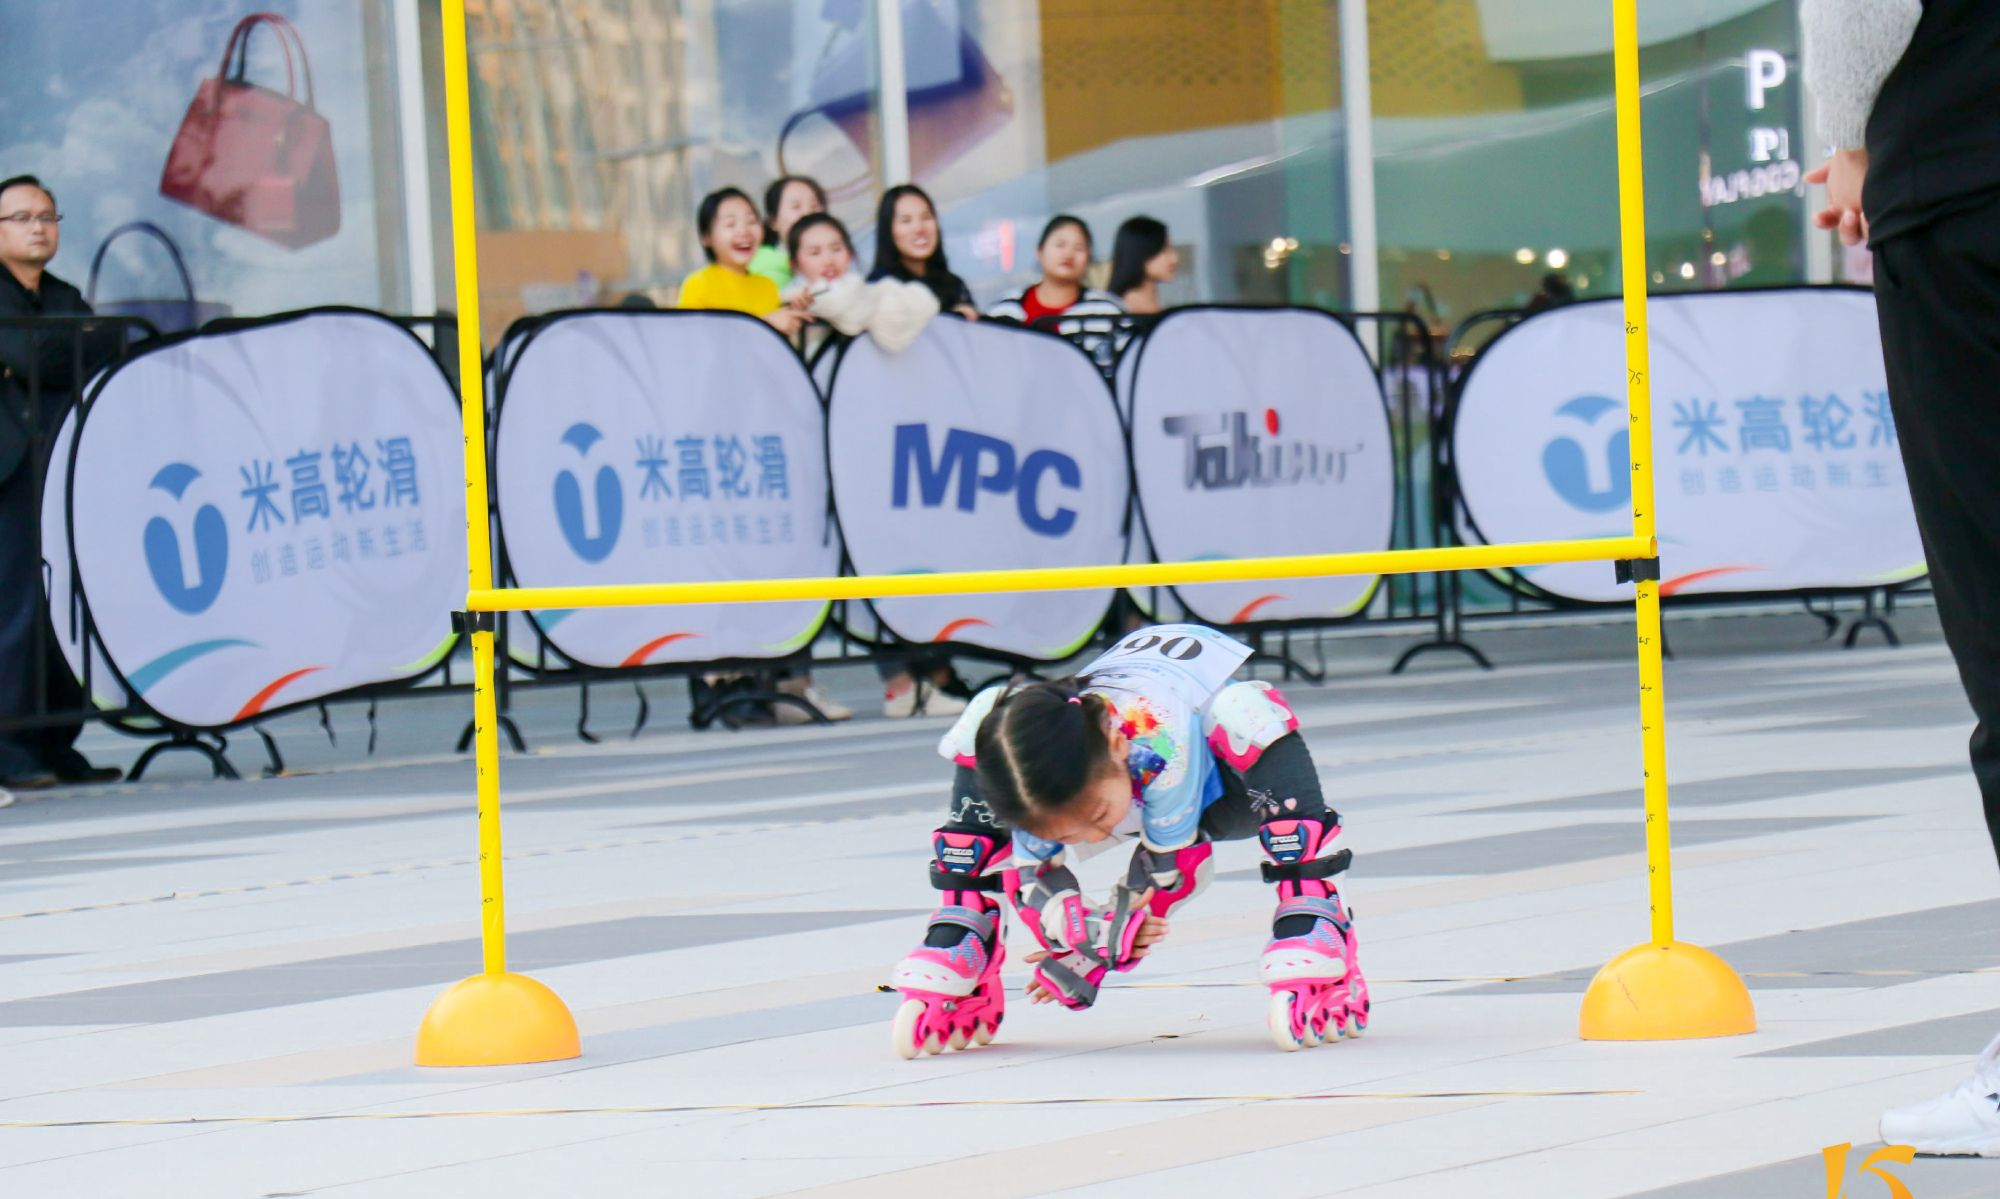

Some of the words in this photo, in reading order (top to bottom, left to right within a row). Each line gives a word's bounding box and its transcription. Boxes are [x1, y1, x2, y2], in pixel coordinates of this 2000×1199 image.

[1747, 48, 1786, 109] P
[240, 437, 420, 533] 米高轮滑
[635, 434, 790, 501] 米高轮滑
[891, 423, 1081, 538] MPC
